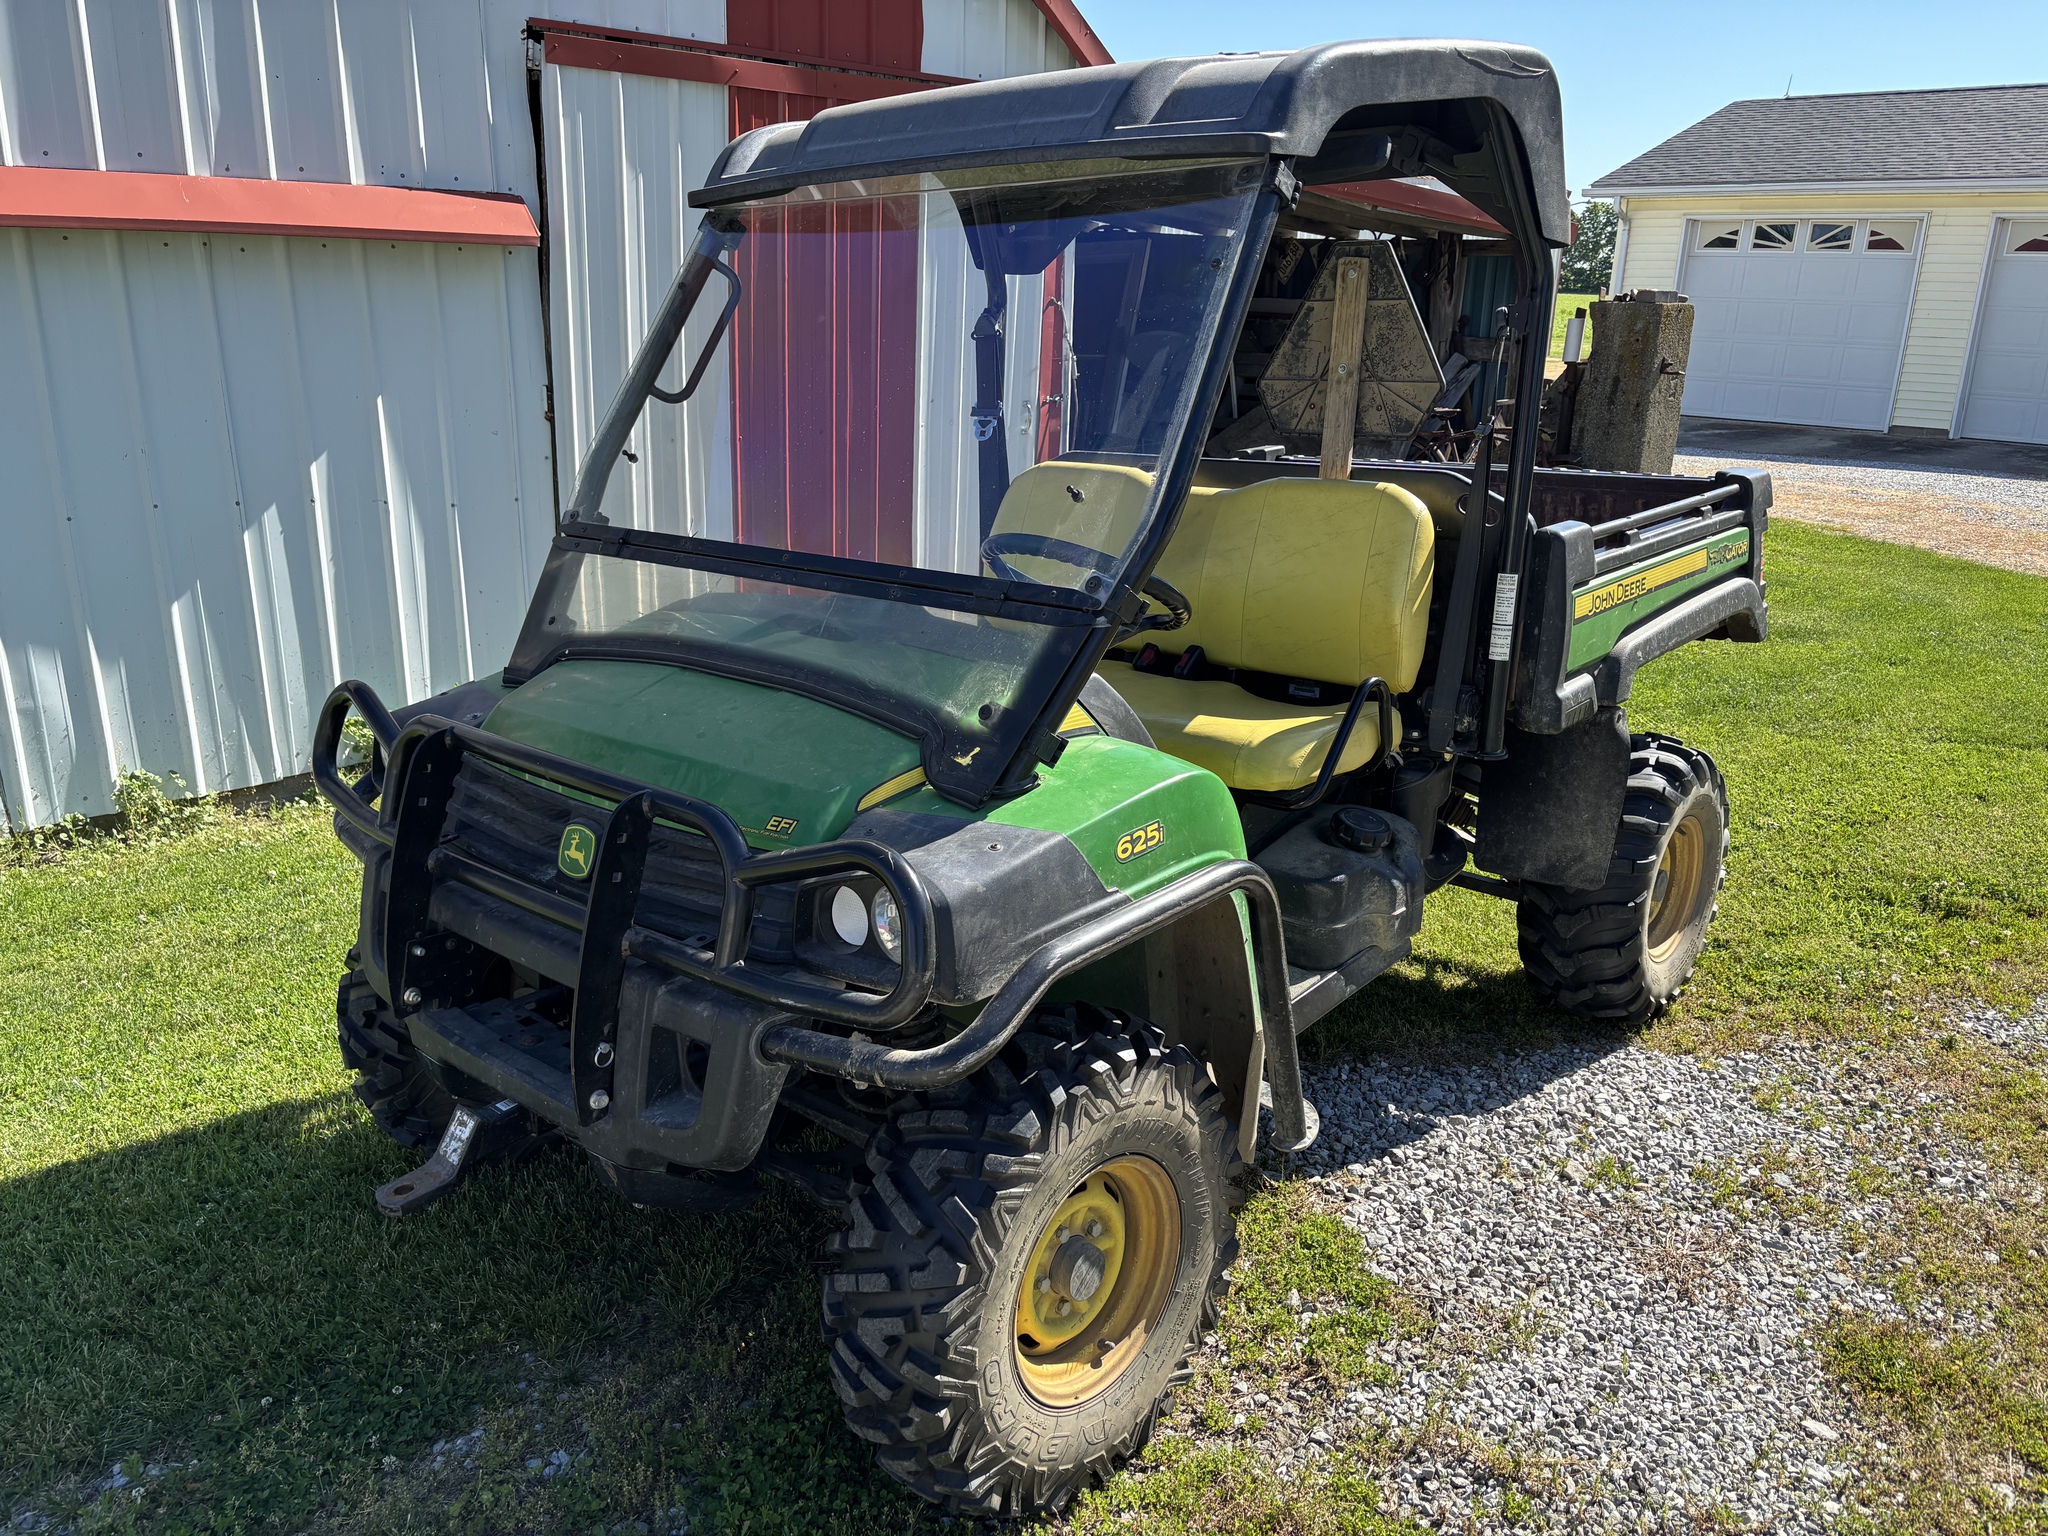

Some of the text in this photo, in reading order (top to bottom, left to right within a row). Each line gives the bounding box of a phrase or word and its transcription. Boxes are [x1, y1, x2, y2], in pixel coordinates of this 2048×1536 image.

[1726, 541, 1748, 561] GATOR
[1588, 577, 1647, 615] JOHN DEERE
[765, 816, 798, 834] EFI
[1116, 822, 1164, 859] 625i
